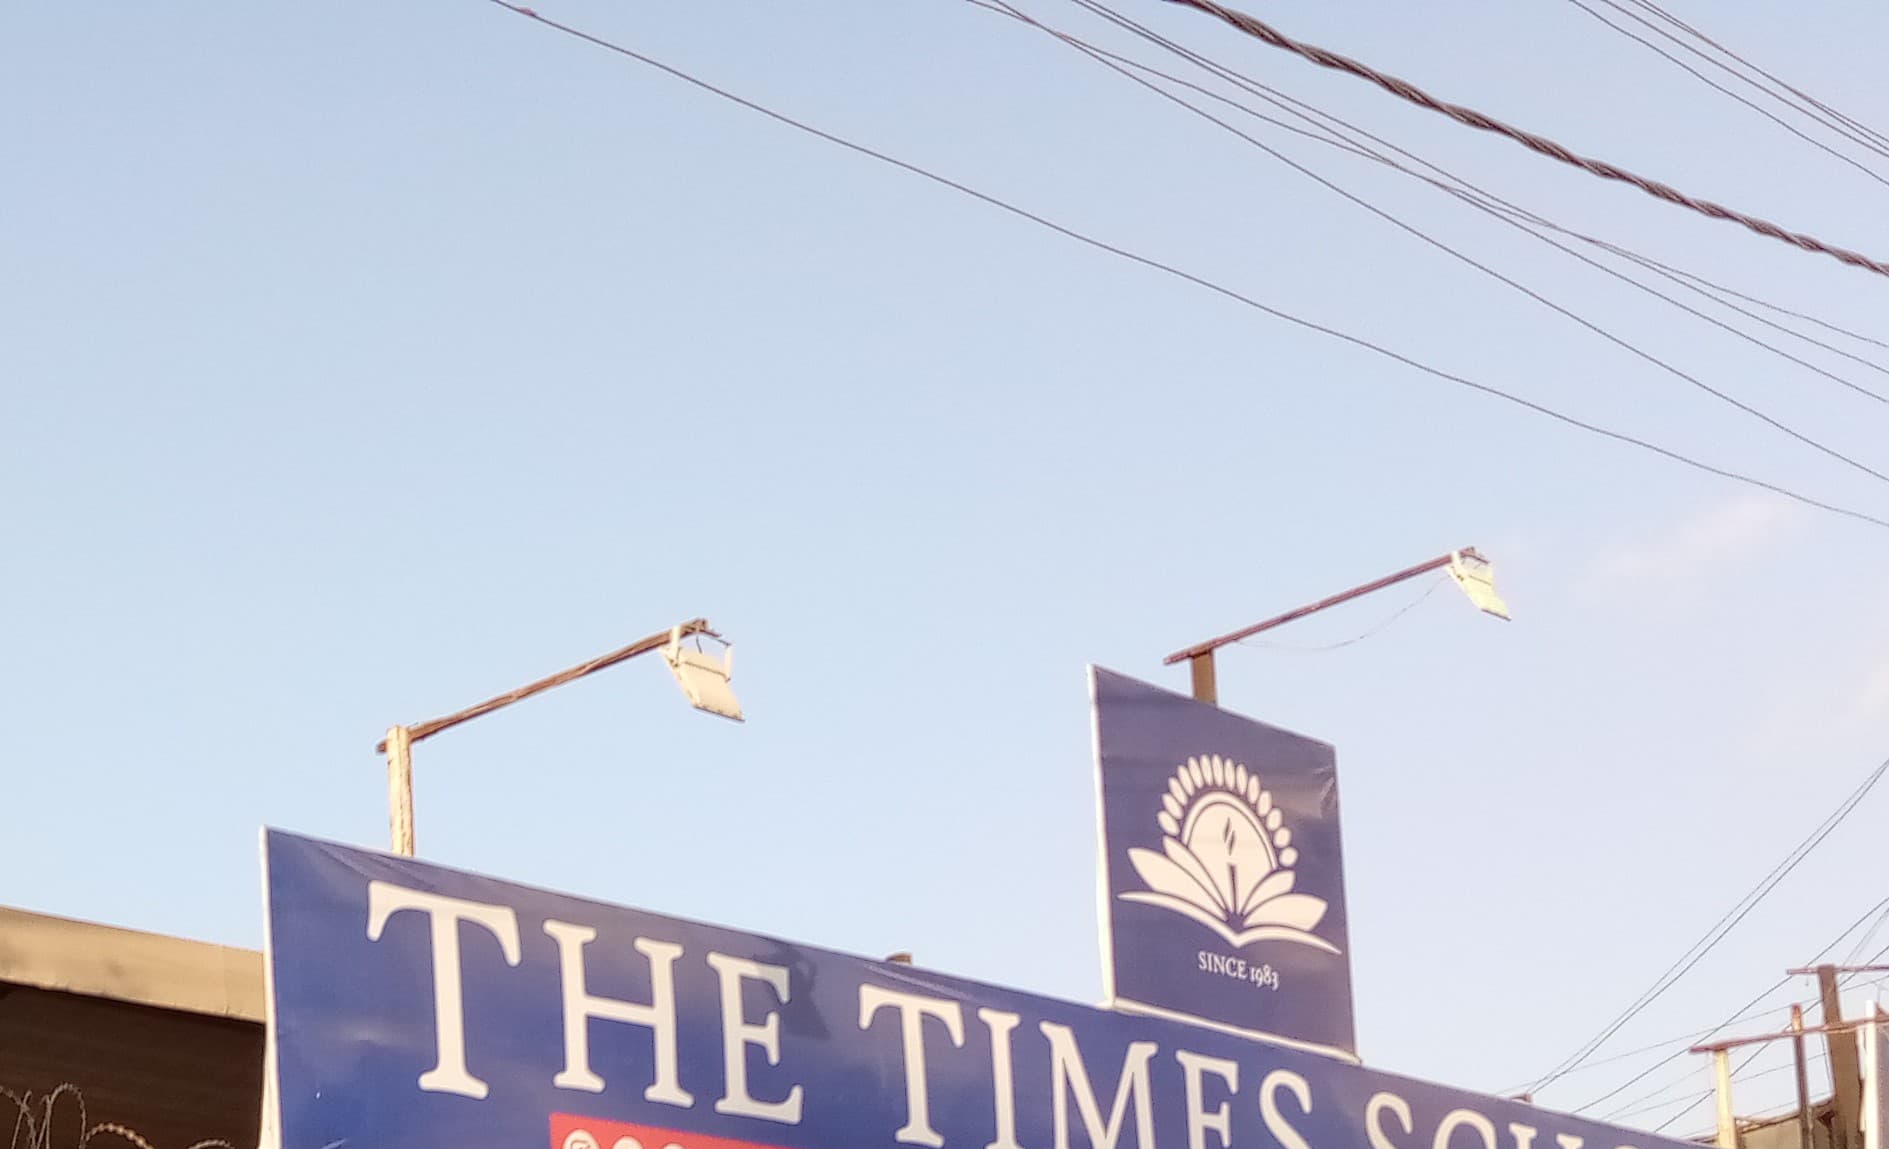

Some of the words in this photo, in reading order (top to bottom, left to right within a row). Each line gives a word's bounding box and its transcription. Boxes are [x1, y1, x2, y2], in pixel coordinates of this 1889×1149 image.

[366, 880, 802, 1125] THE
[1198, 951, 1247, 980] SINCE
[1250, 964, 1279, 991] 1983
